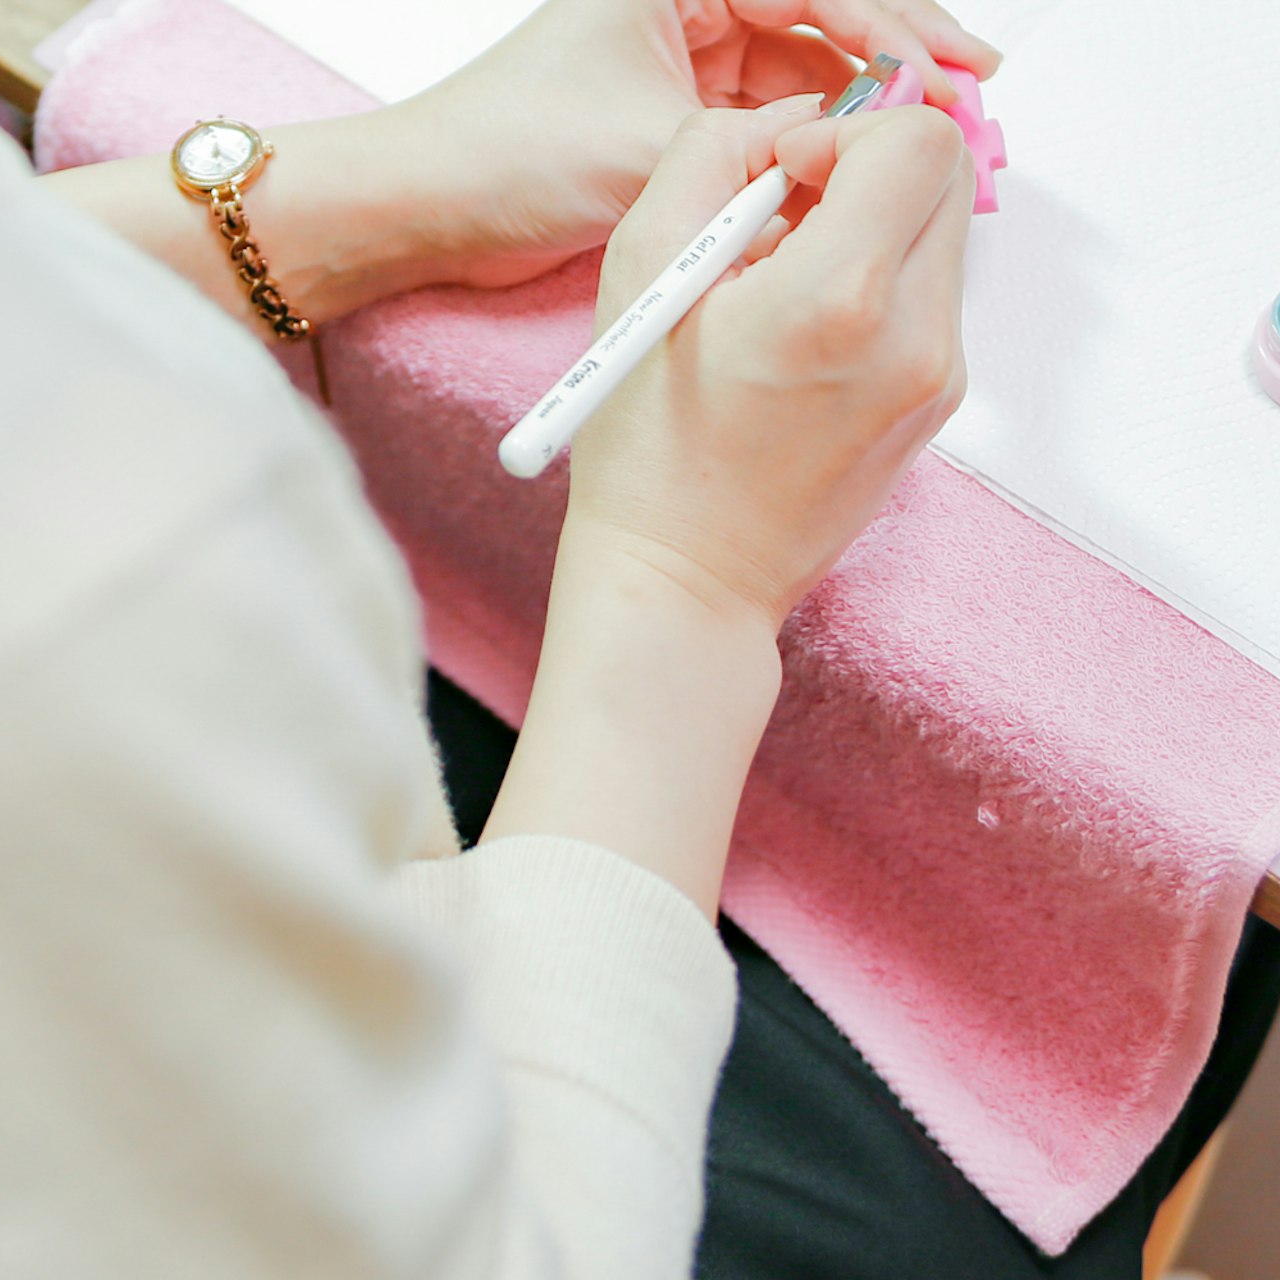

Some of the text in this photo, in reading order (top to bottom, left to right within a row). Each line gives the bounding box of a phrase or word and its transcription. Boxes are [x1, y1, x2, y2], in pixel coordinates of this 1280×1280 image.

[695, 235, 717, 254] Gel
[676, 252, 701, 272] Flat
[639, 290, 663, 311] New
[600, 311, 644, 352] Synthetic
